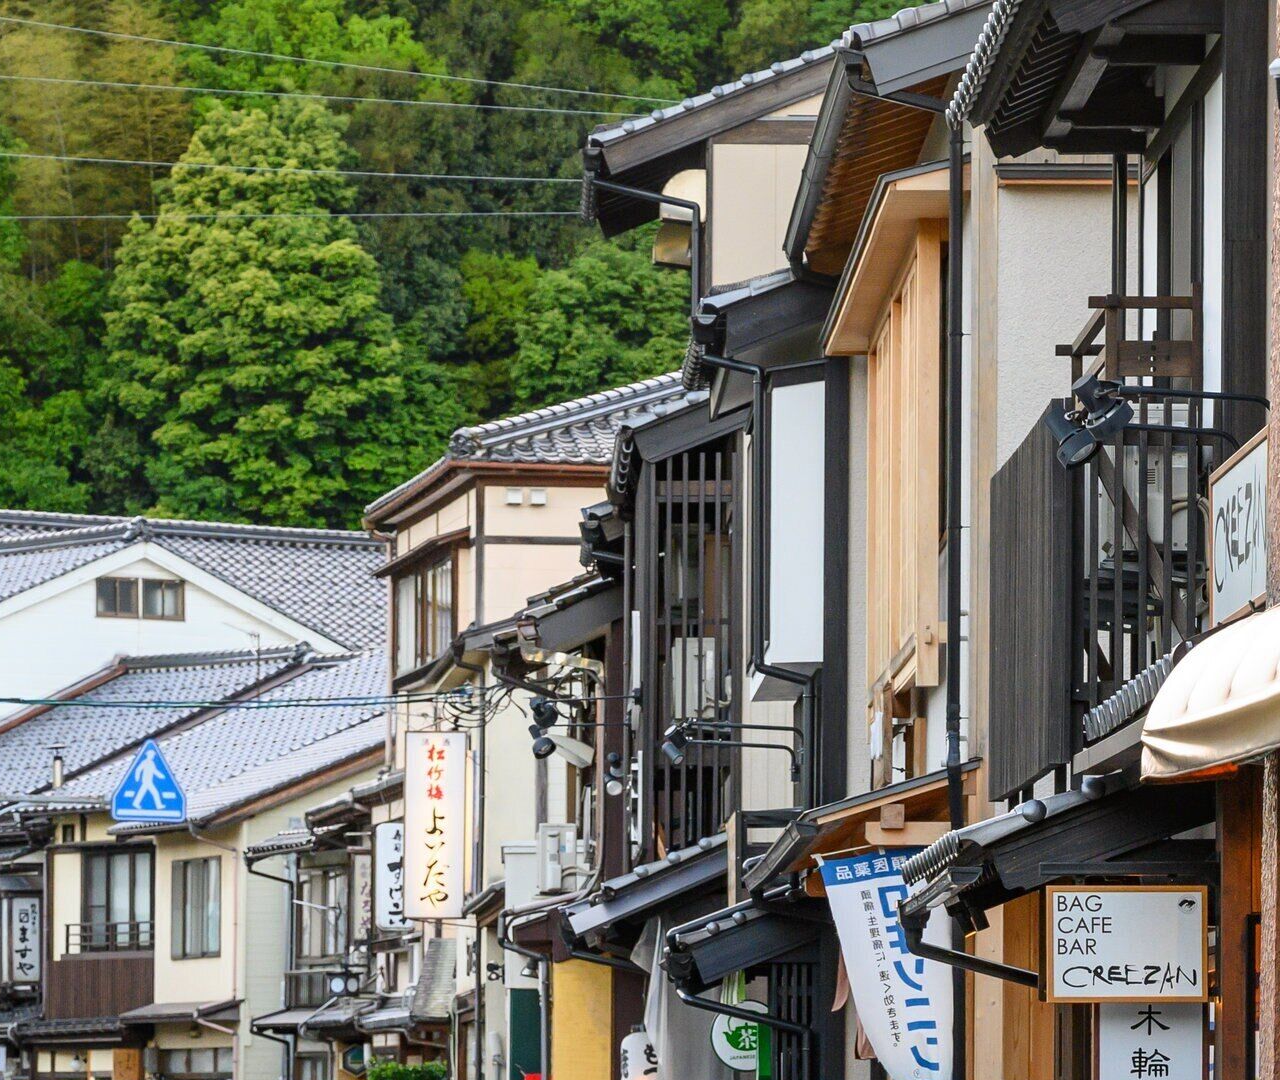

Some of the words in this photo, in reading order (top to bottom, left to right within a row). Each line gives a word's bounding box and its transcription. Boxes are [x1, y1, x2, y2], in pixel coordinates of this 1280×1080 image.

[420, 806, 450, 909] よいだや
[1057, 895, 1103, 912] BAG
[1057, 917, 1112, 934] CAFE
[15, 926, 35, 976] ますや
[1057, 938, 1097, 955] BAR
[1062, 961, 1198, 994] CREEZAN
[1130, 1004, 1171, 1080] 木輪
